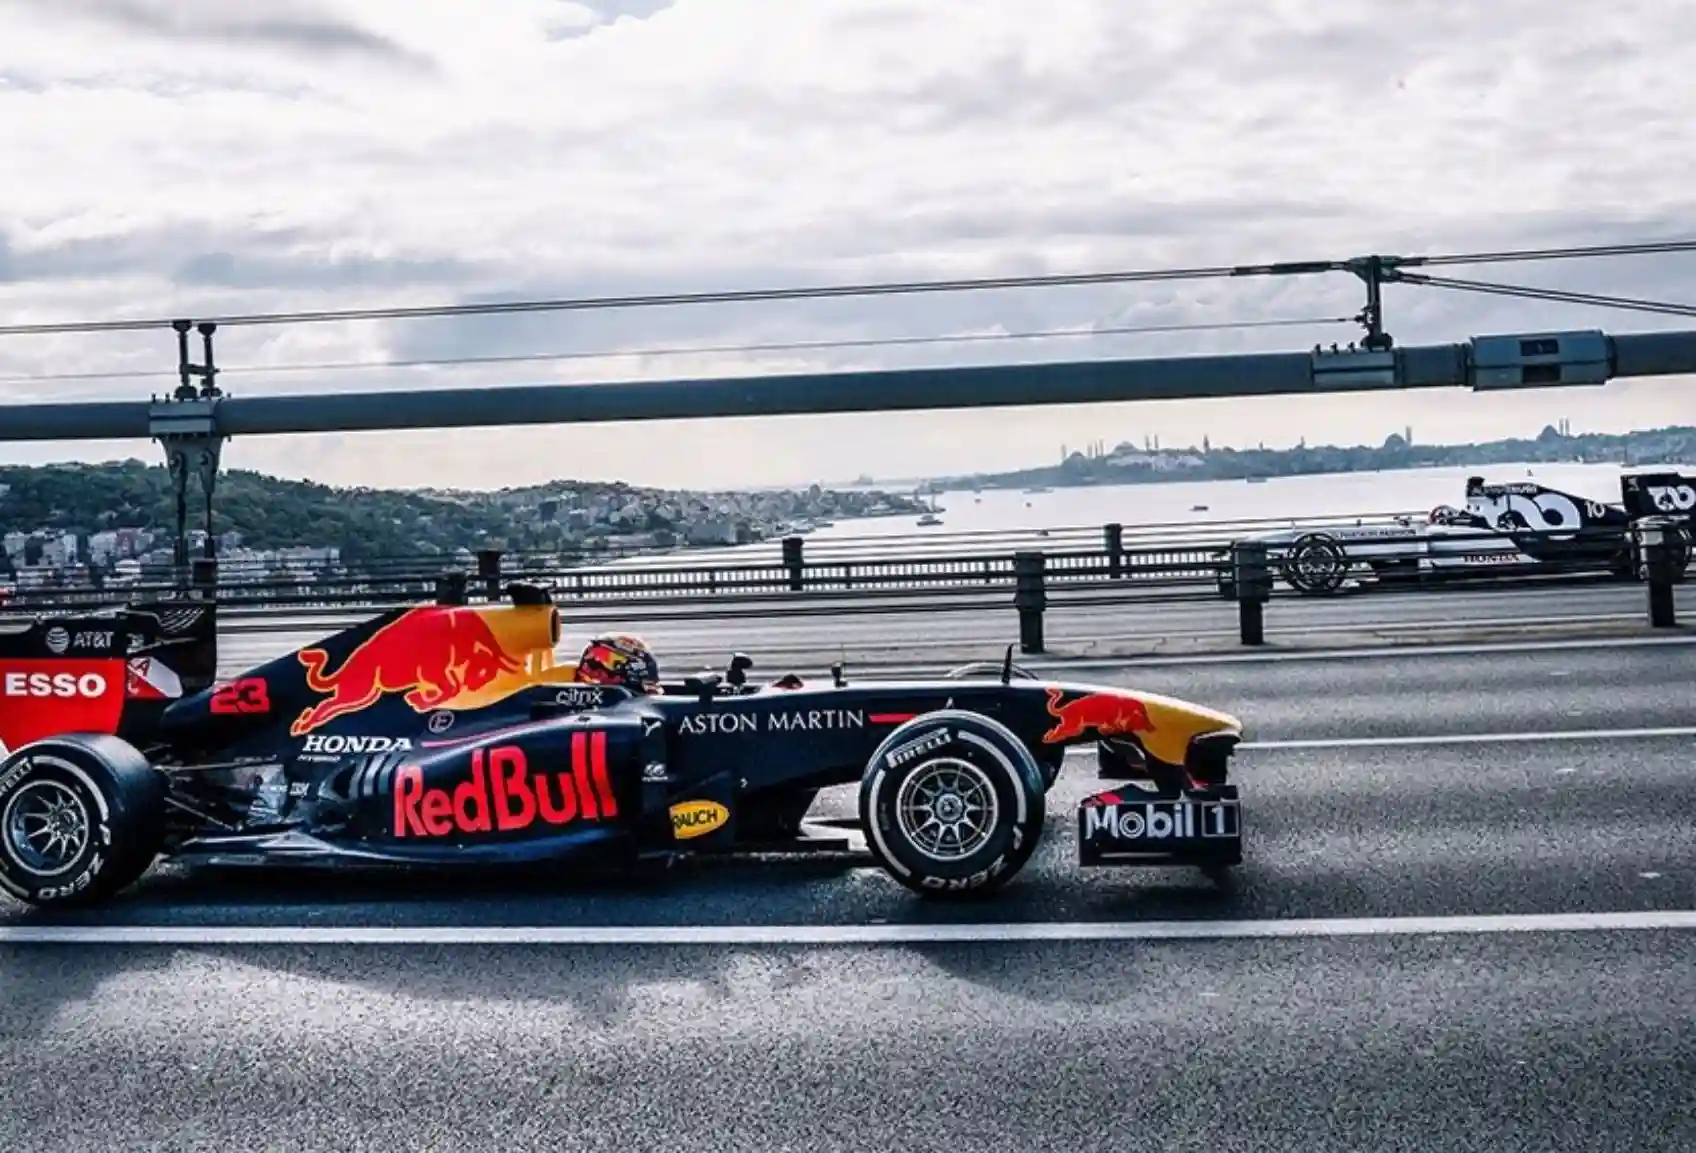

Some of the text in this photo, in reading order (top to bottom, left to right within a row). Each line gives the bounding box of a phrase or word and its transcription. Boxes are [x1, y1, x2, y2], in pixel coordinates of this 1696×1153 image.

[1584, 500, 1606, 519] 10
[73, 631, 115, 648] AT&T
[5, 672, 107, 697] ESSO
[209, 677, 270, 713] 23
[556, 687, 604, 705] citrix
[678, 708, 864, 735] ASTON MARTIN
[302, 734, 414, 753] HONDA
[885, 727, 952, 769] PIRELLI
[671, 809, 718, 829] RAUCH
[1085, 802, 1225, 840] Mobil 1
